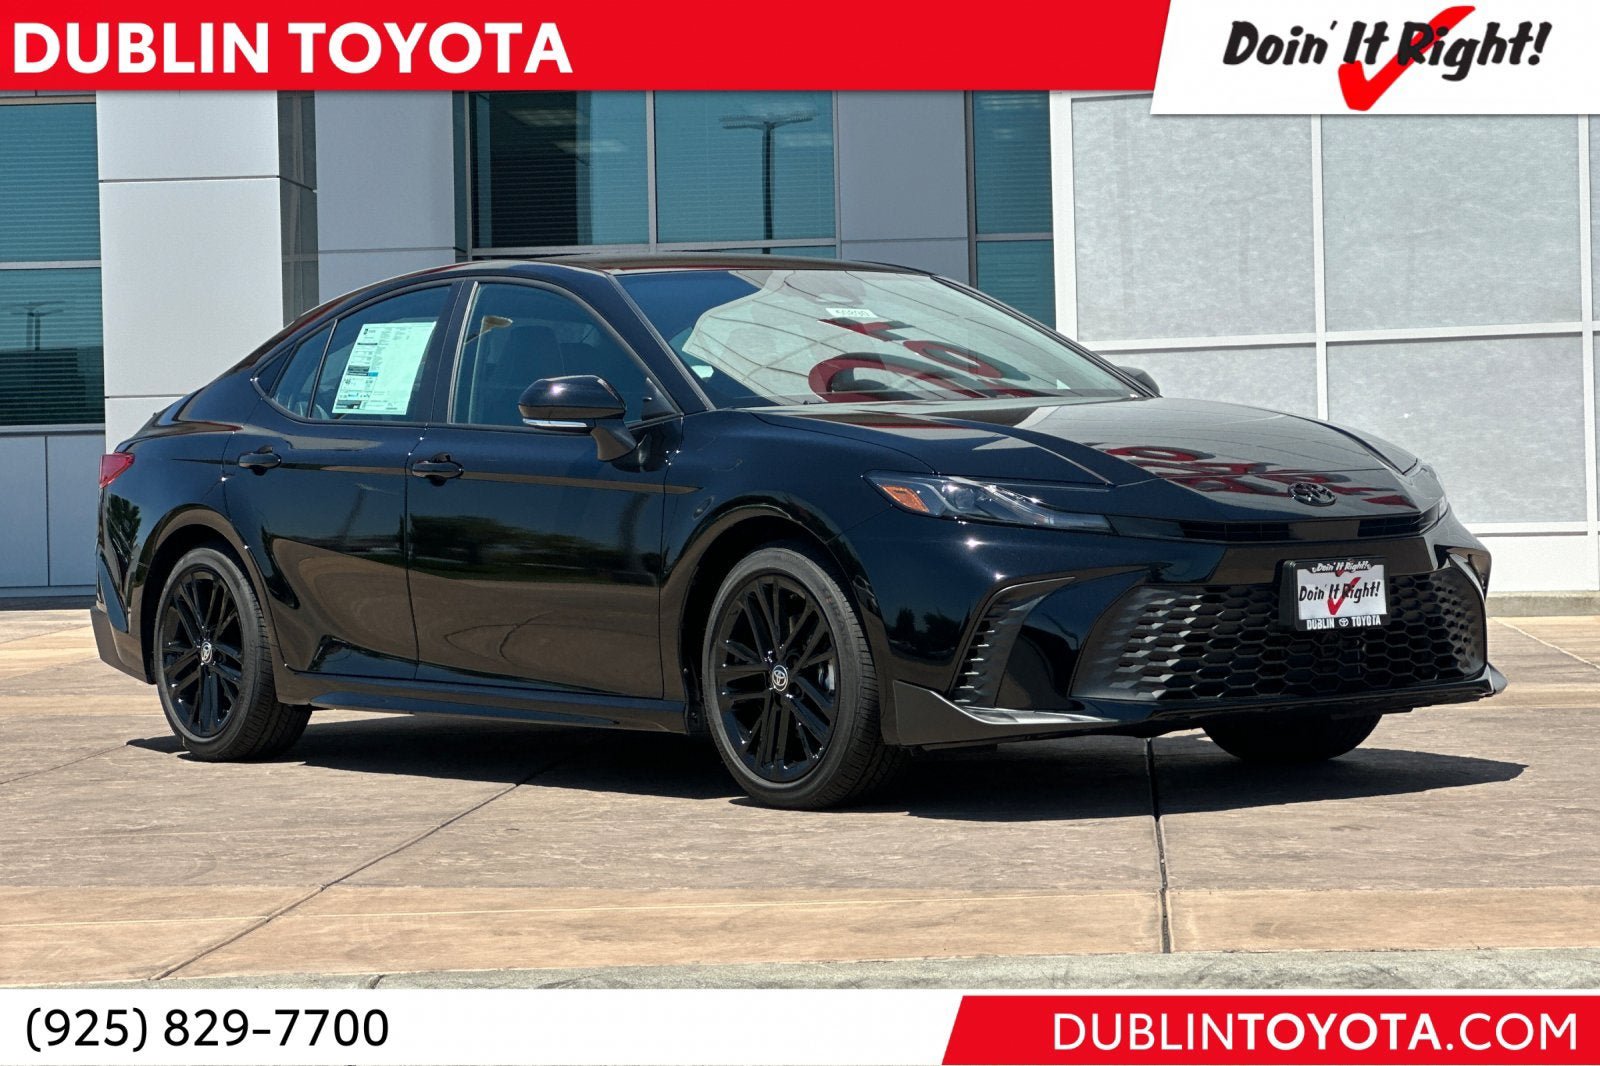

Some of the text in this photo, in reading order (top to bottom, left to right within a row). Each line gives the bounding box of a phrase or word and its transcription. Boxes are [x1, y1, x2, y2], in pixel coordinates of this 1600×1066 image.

[1299, 581, 1381, 604] Doin' It Right!
[1306, 615, 1382, 630] DUBLIN TOYOTA
